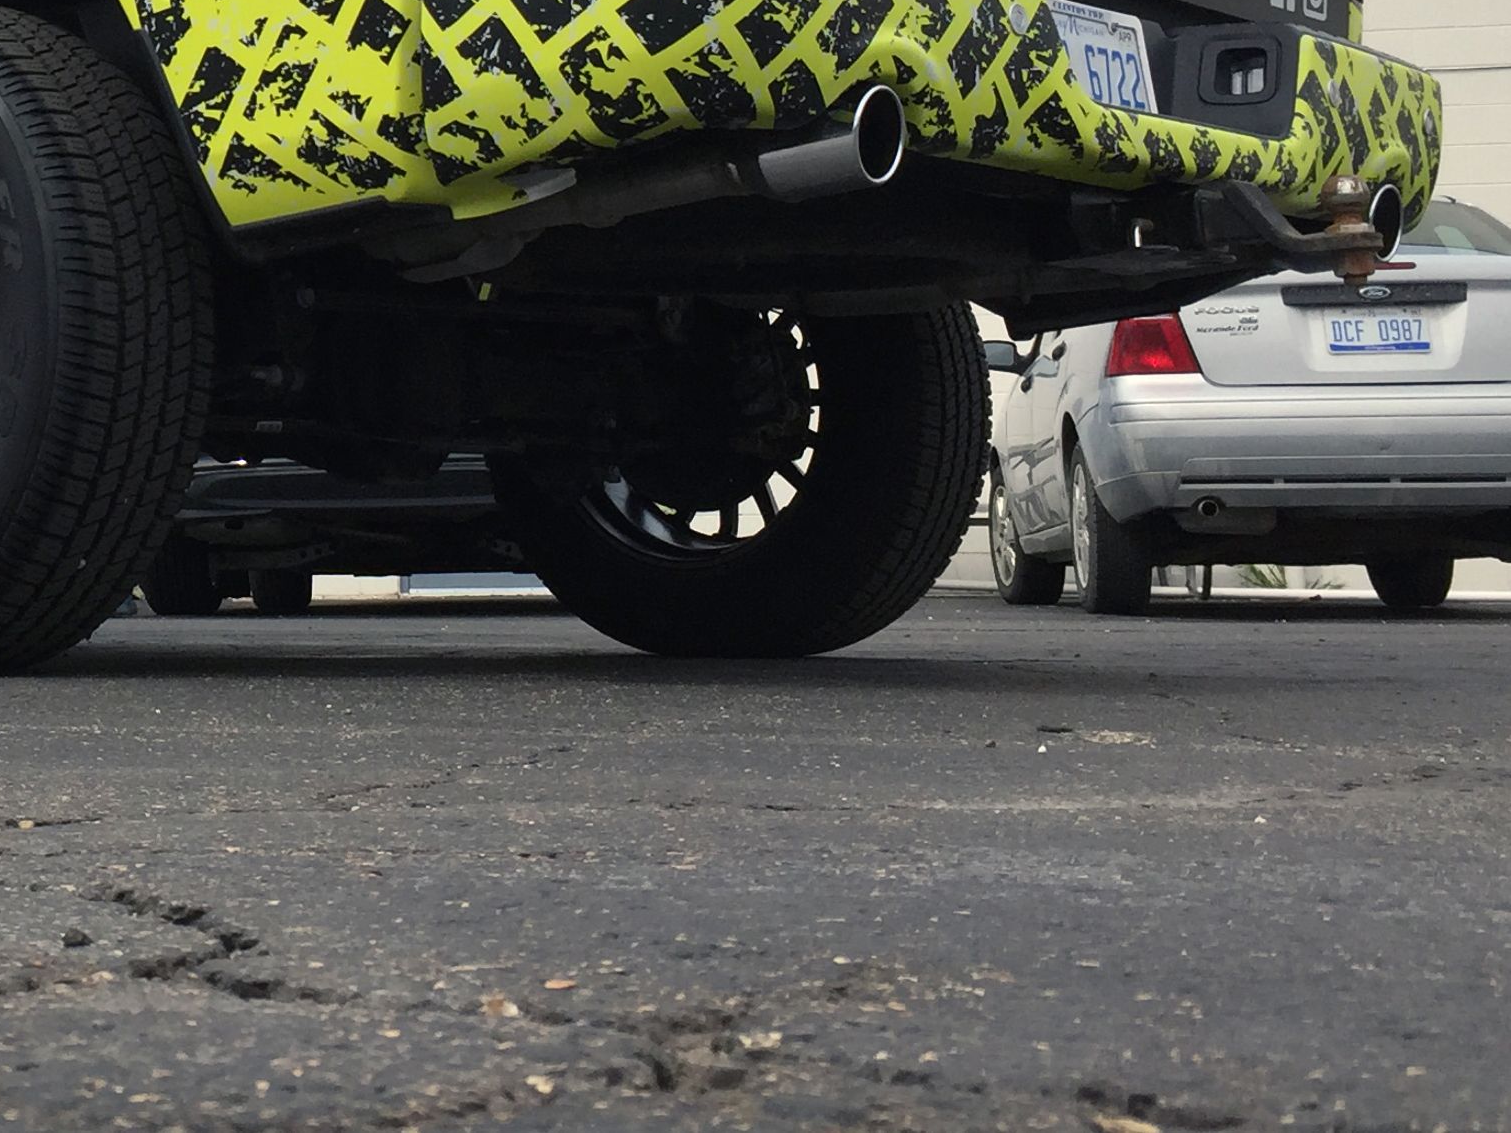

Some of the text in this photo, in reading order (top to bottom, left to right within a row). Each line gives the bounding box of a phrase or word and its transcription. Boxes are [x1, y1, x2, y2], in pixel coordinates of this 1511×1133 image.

[1084, 44, 1146, 109] 6722
[1331, 319, 1422, 342] DCF 0987
